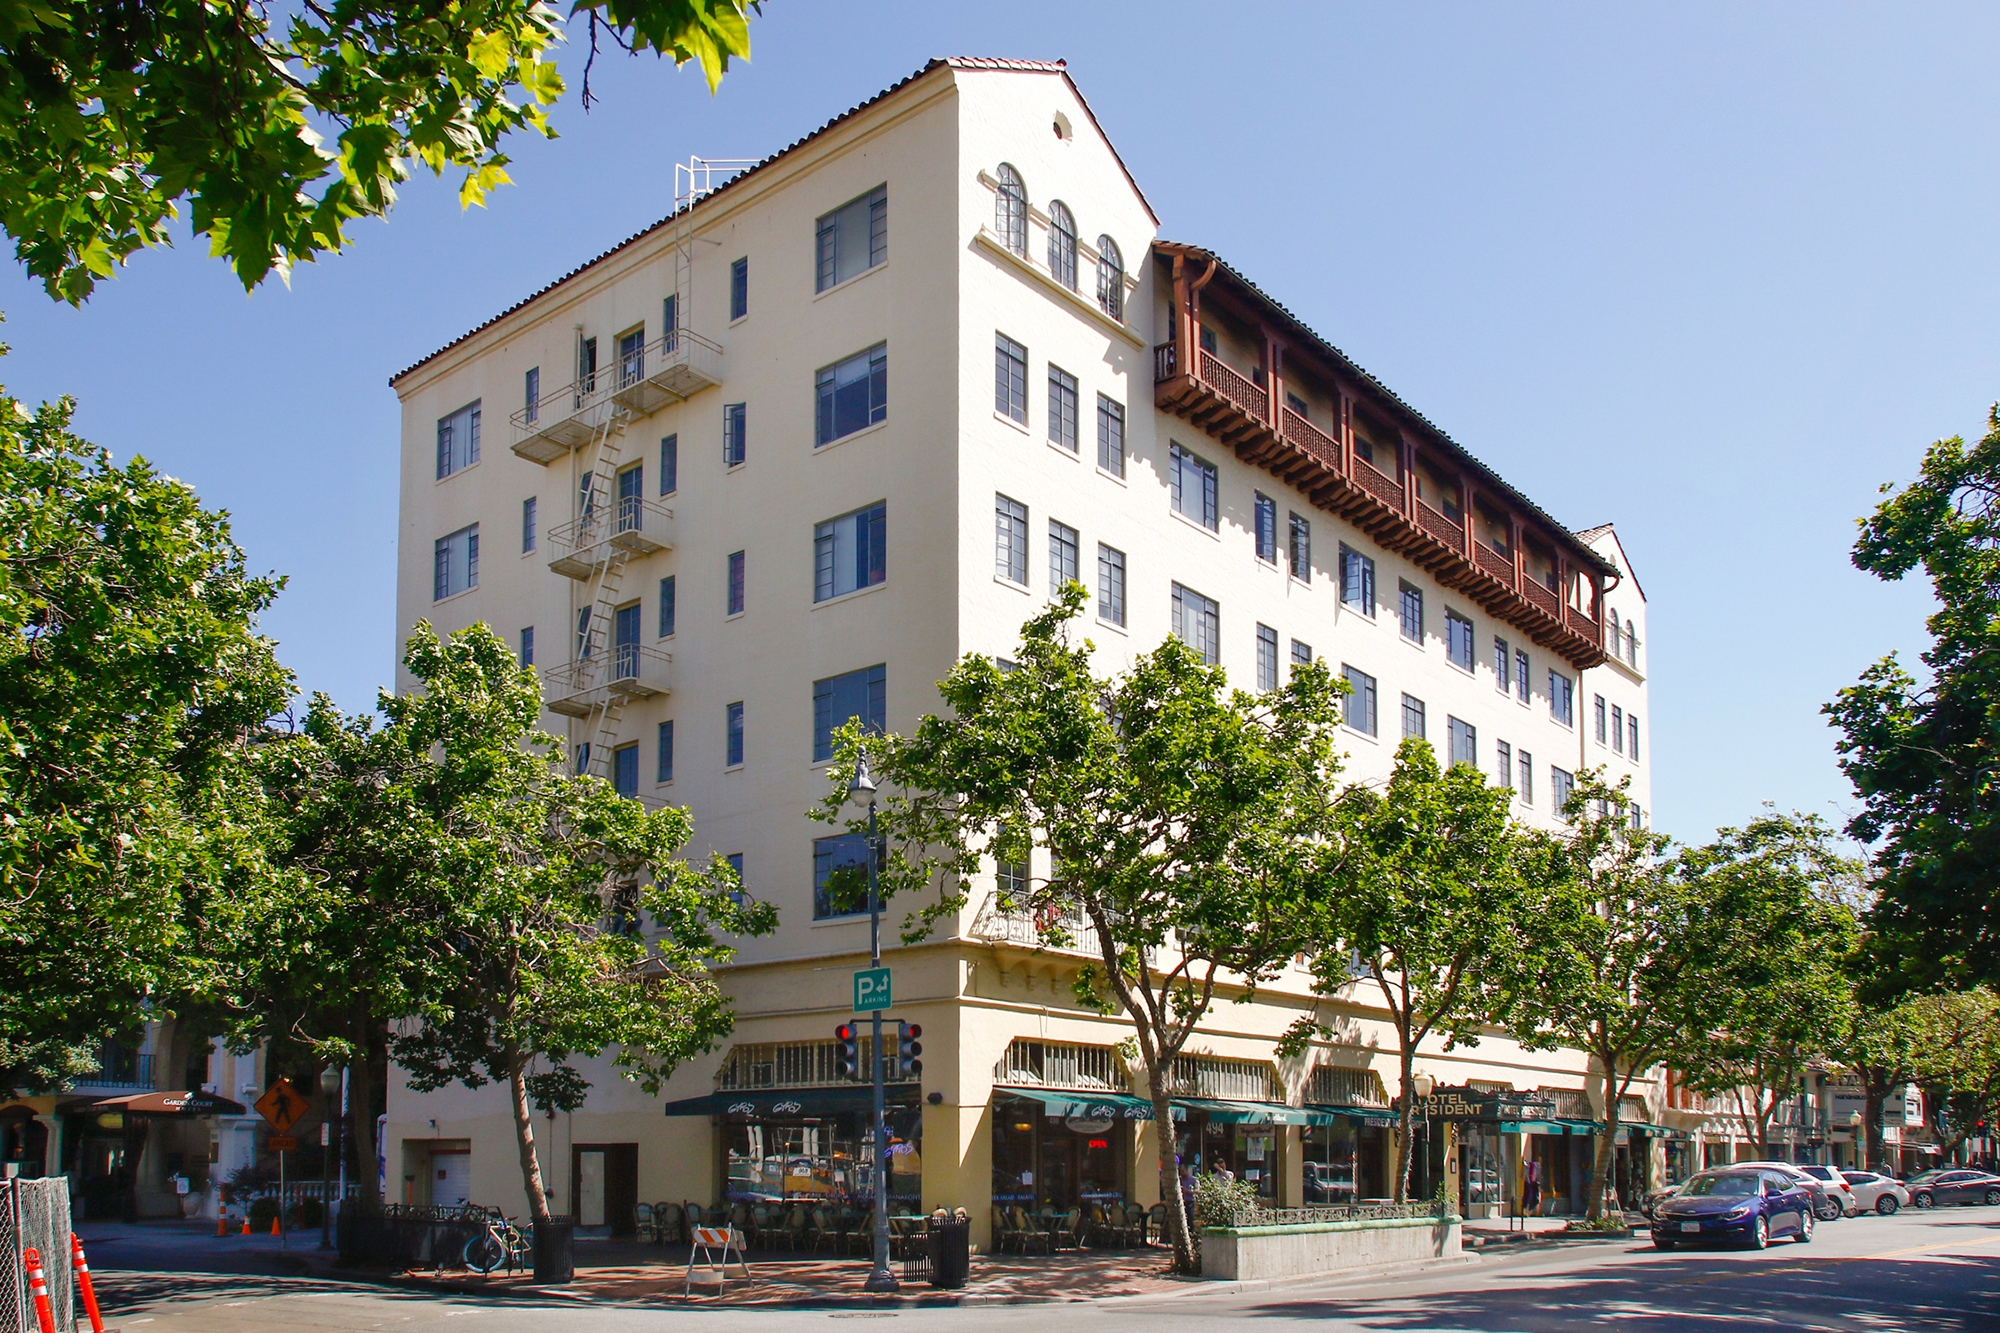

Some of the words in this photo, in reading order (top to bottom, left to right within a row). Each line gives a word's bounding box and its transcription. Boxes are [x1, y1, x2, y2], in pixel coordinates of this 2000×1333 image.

[163, 1098, 189, 1106] GARDEN
[1417, 1094, 1467, 1105] OTEL
[1206, 1122, 1224, 1134] 494
[1088, 1139, 1108, 1149] OPEN
